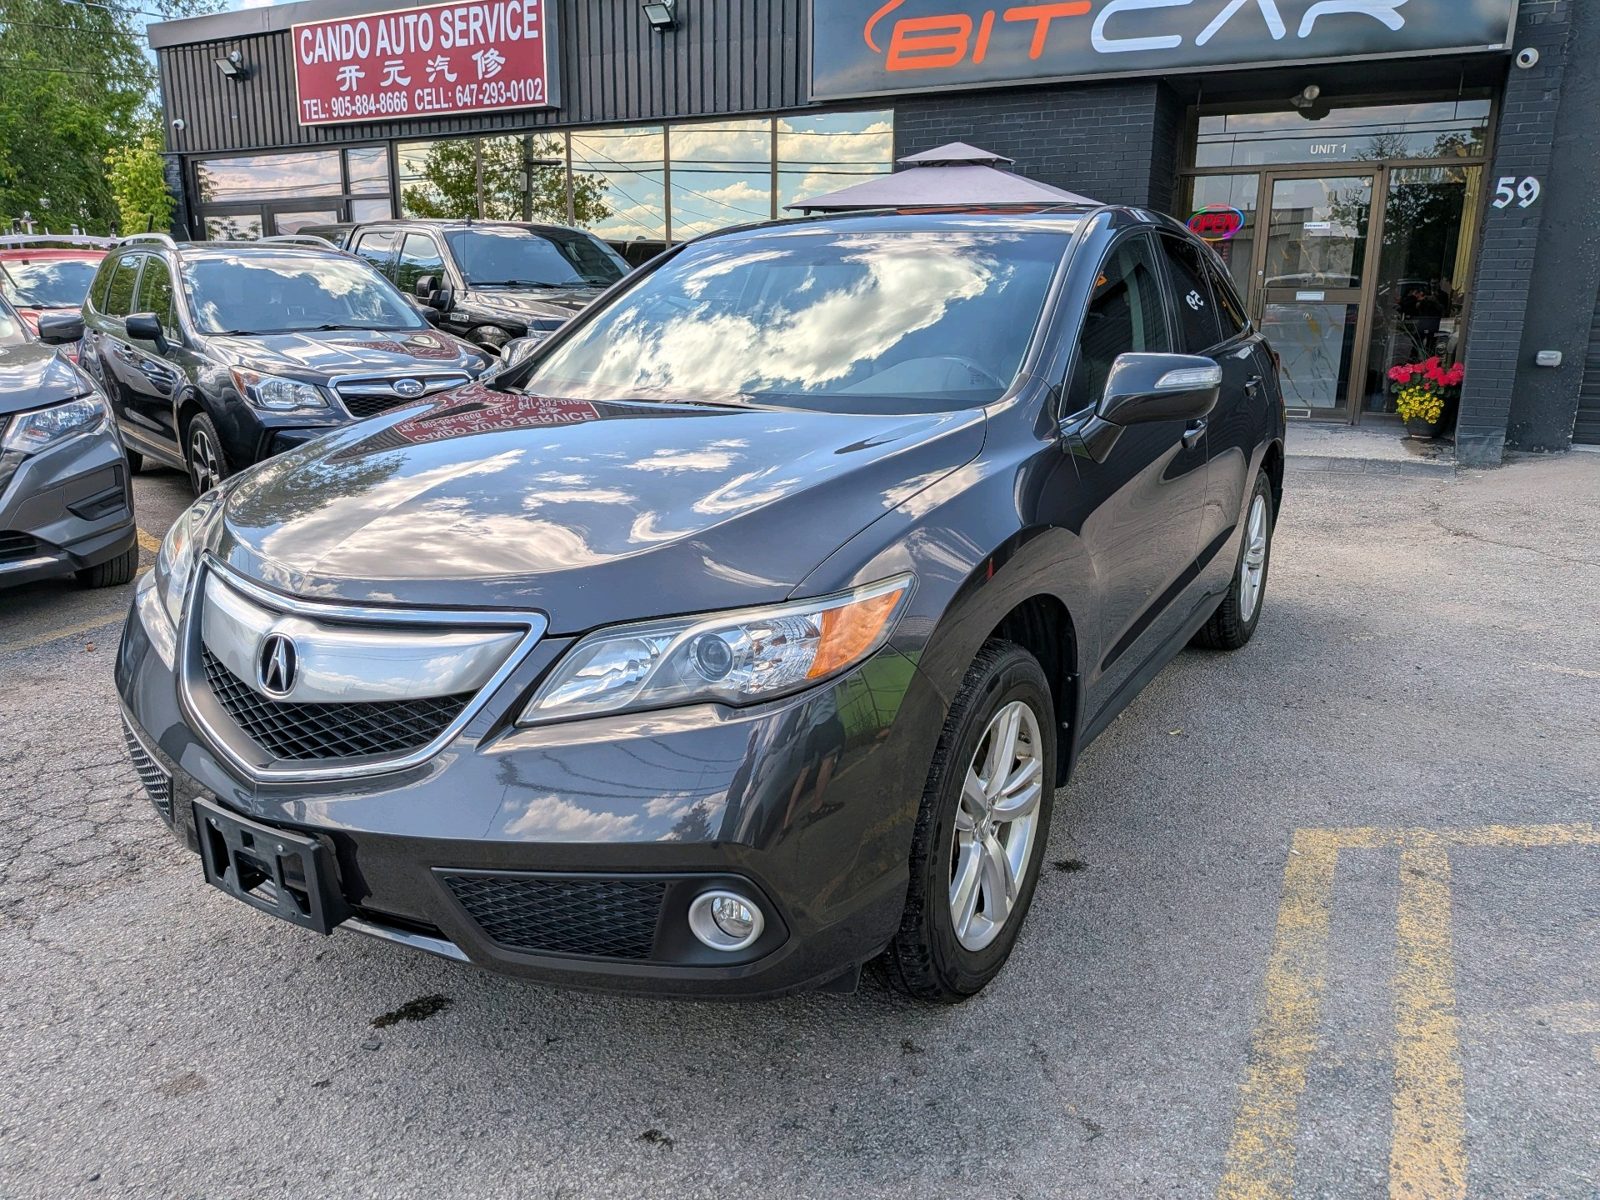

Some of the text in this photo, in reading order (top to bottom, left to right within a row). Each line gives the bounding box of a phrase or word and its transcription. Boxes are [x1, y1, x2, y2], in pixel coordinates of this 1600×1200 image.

[301, 0, 539, 65] CANDO AUTO SERVICE
[336, 48, 506, 92] 开元汽修
[303, 78, 542, 120] TEL: 905-884-8666 CELL: 647-293-0102
[1310, 143, 1347, 154] UNIT 1
[1492, 176, 1540, 209] 59
[1189, 213, 1240, 234] OPEN
